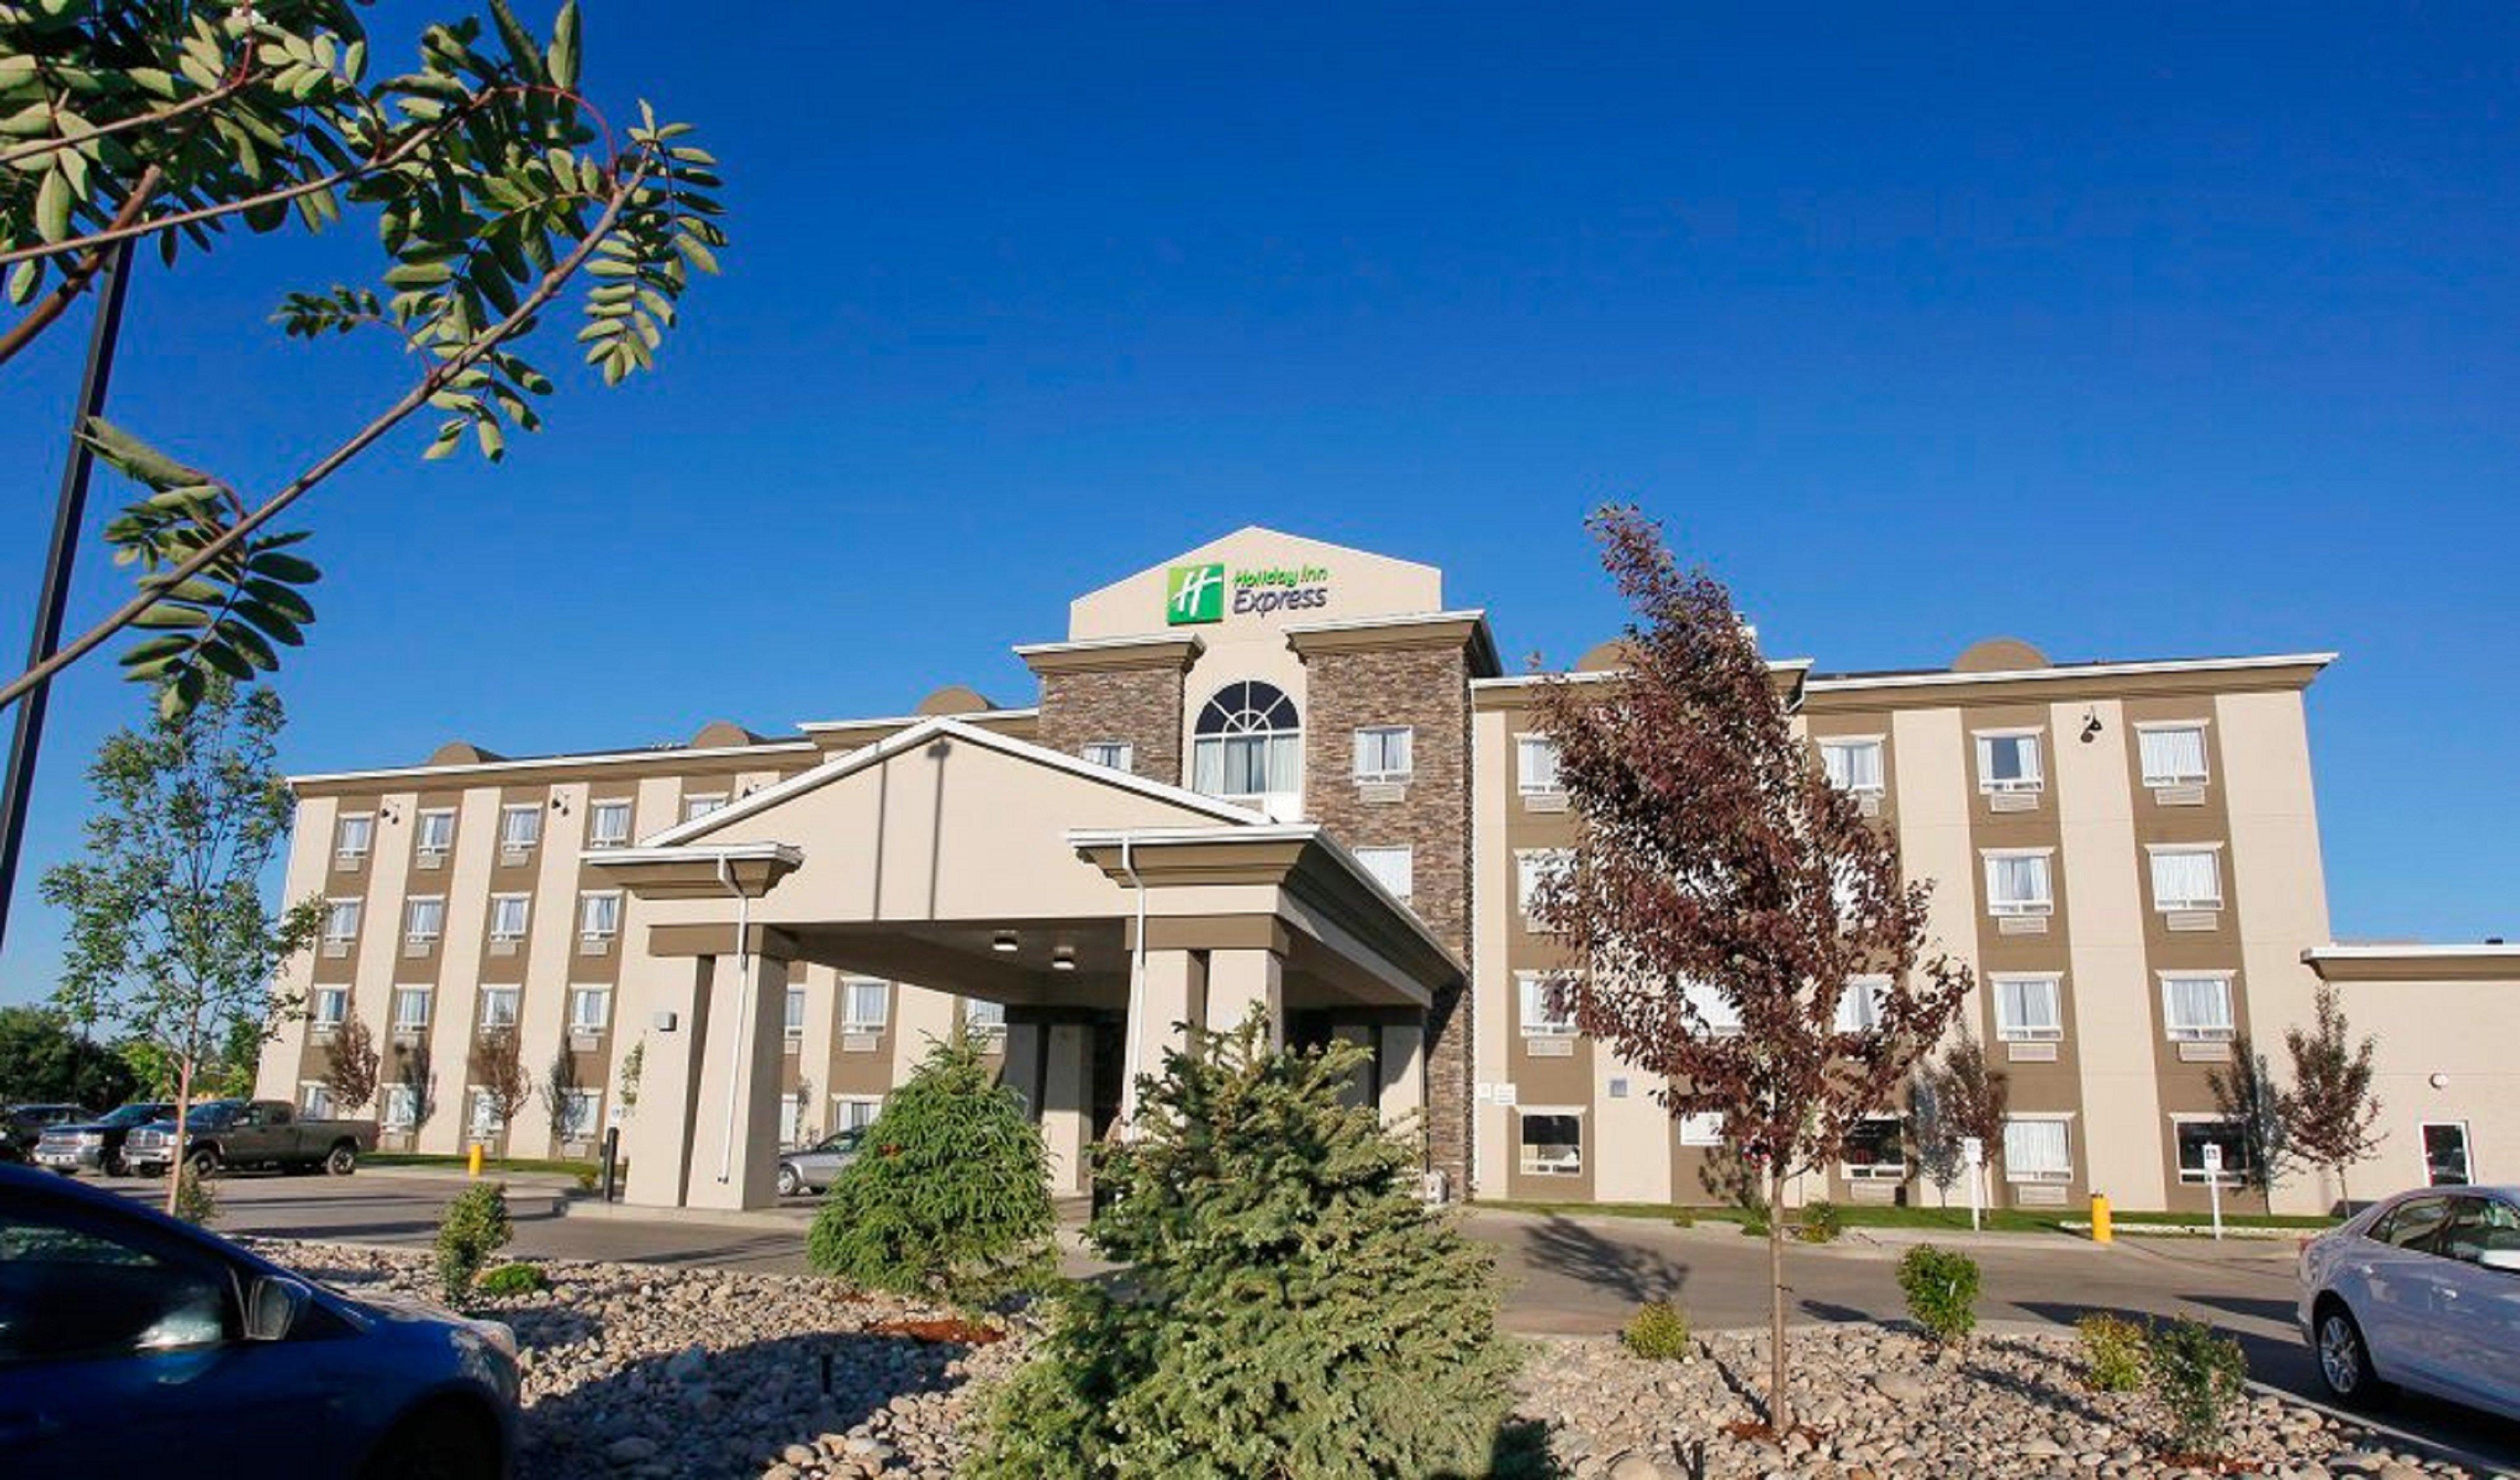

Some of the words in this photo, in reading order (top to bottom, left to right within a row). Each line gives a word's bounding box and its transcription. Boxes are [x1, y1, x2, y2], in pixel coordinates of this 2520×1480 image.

[1233, 566, 1298, 587] Holiday
[1300, 564, 1328, 583] Inn
[1233, 588, 1328, 618] Express
